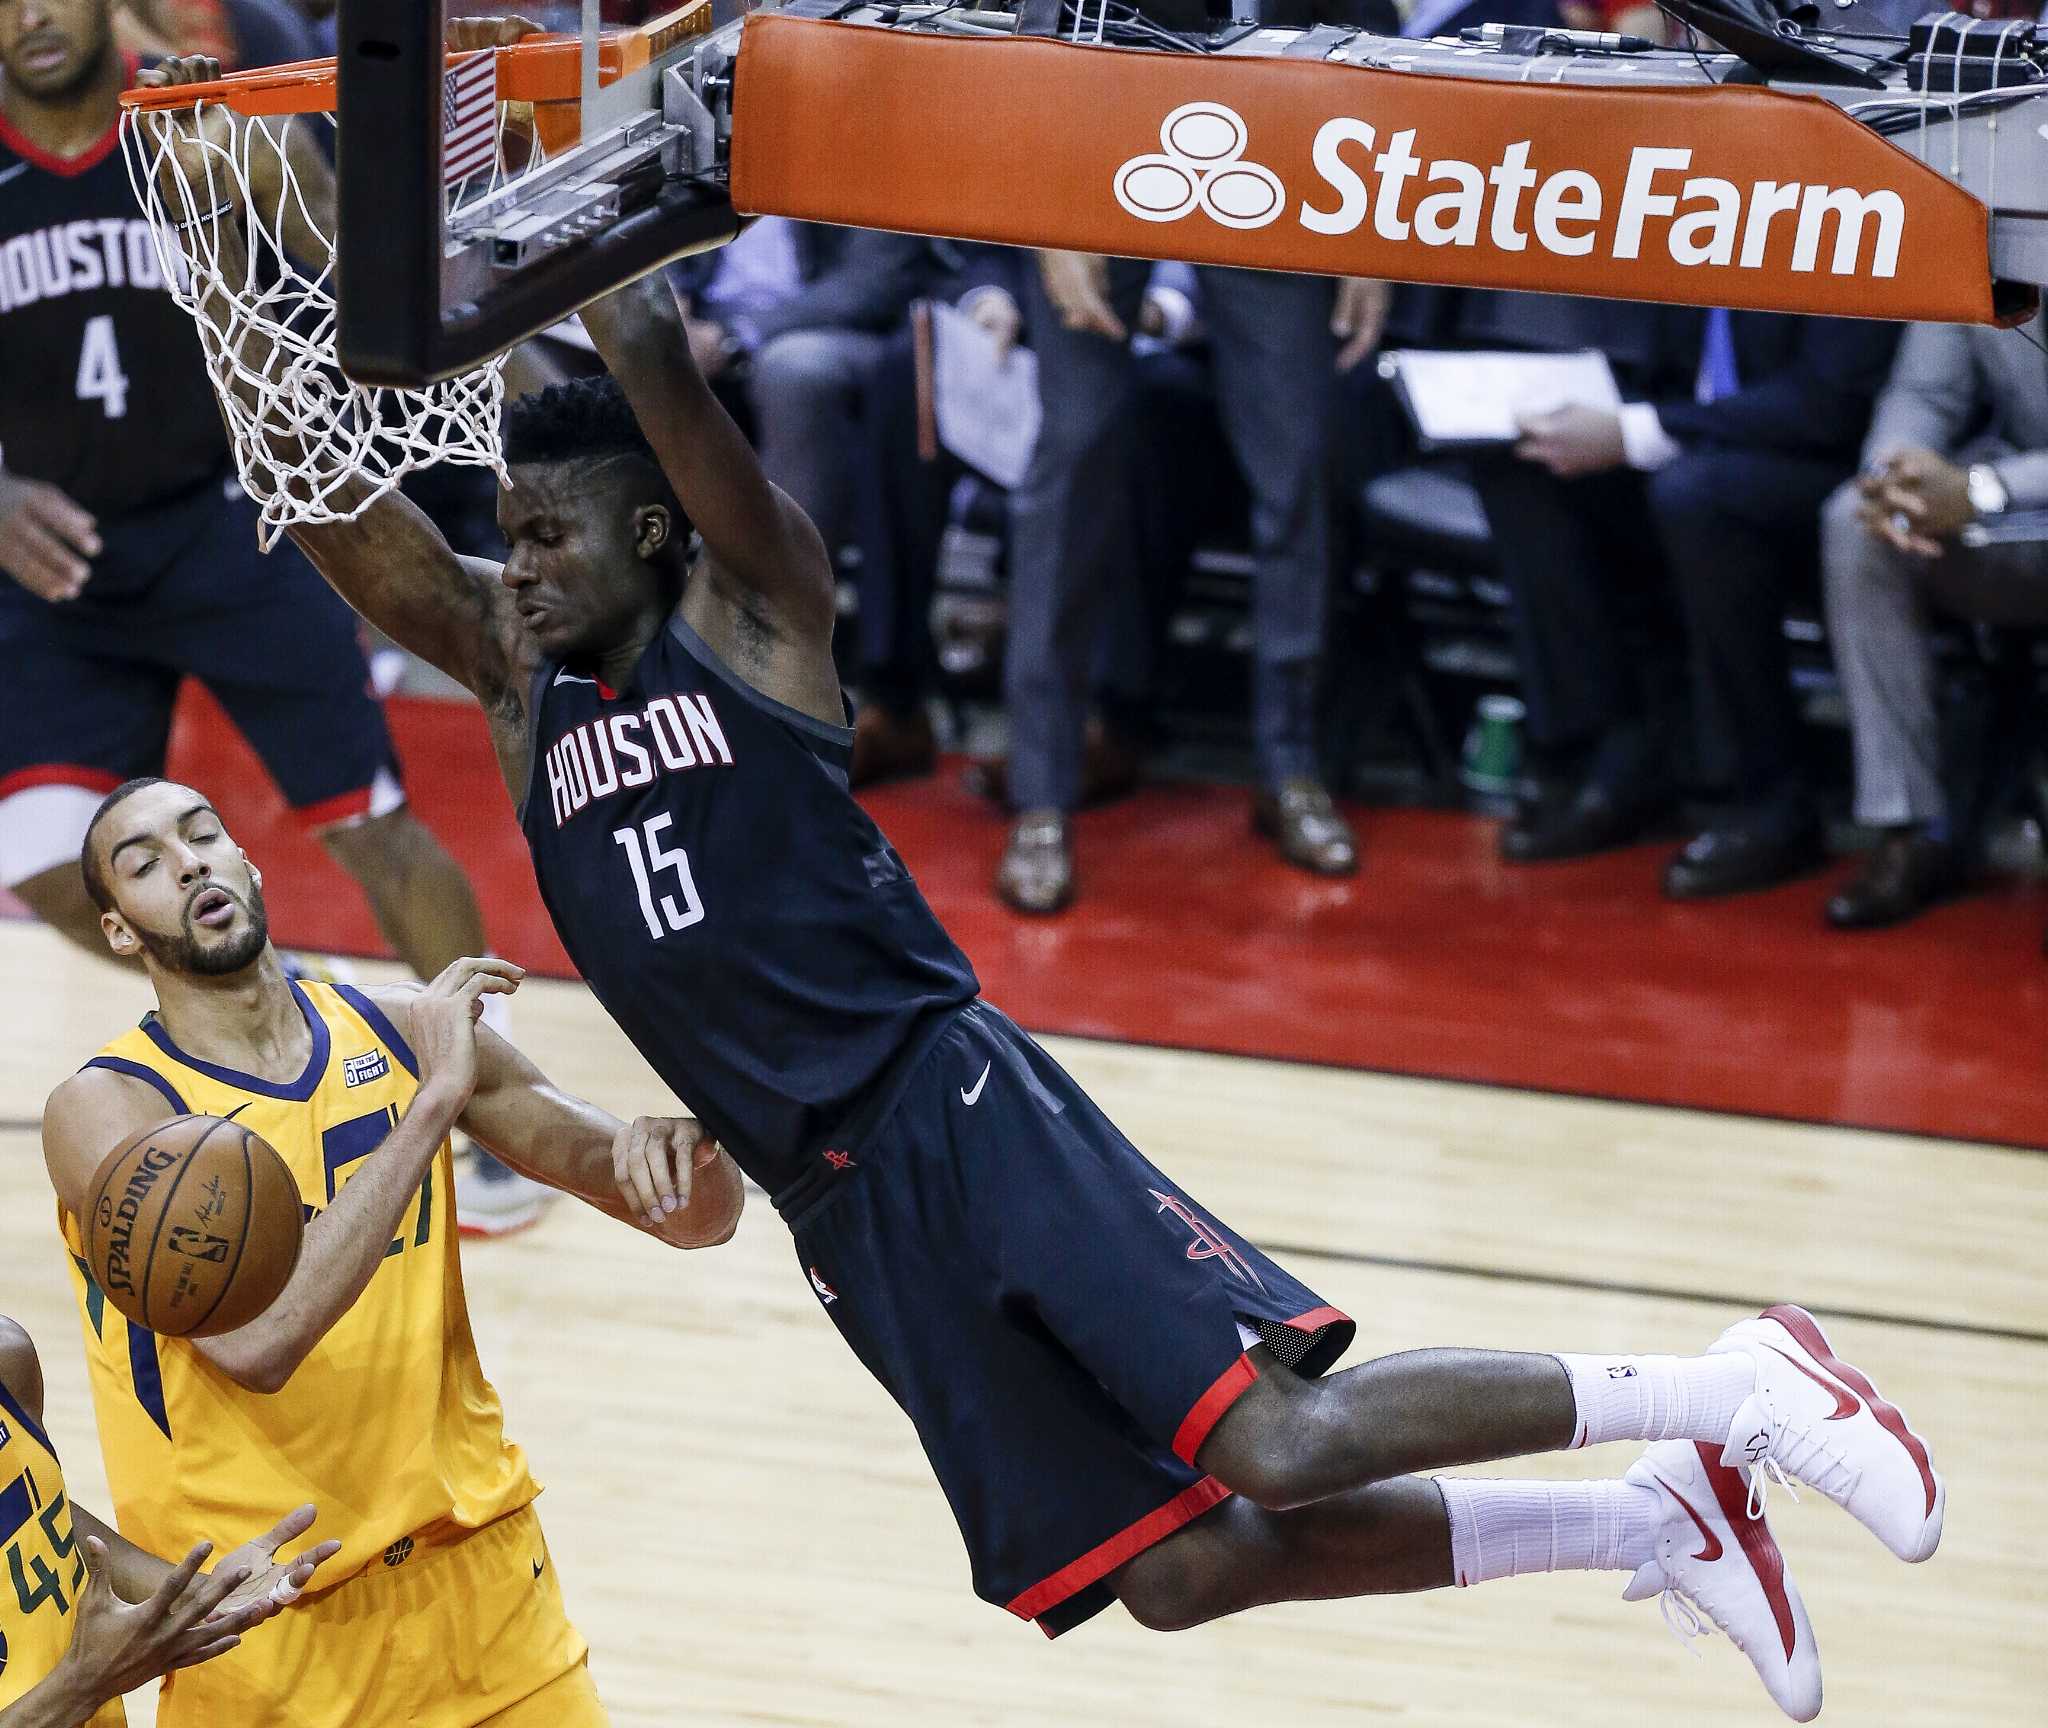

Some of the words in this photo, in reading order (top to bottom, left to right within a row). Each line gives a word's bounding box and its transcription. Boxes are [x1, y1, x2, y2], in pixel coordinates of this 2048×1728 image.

[1300, 117, 1602, 257] State
[1612, 146, 1906, 278] Farm
[77, 316, 129, 418] 4
[546, 694, 733, 829] HOUSON
[613, 811, 705, 940] 15
[346, 1063, 355, 1083] 5
[358, 1062, 384, 1080] FIGHT
[107, 1147, 178, 1296] SPALDING
[6, 1489, 85, 1617] 45
